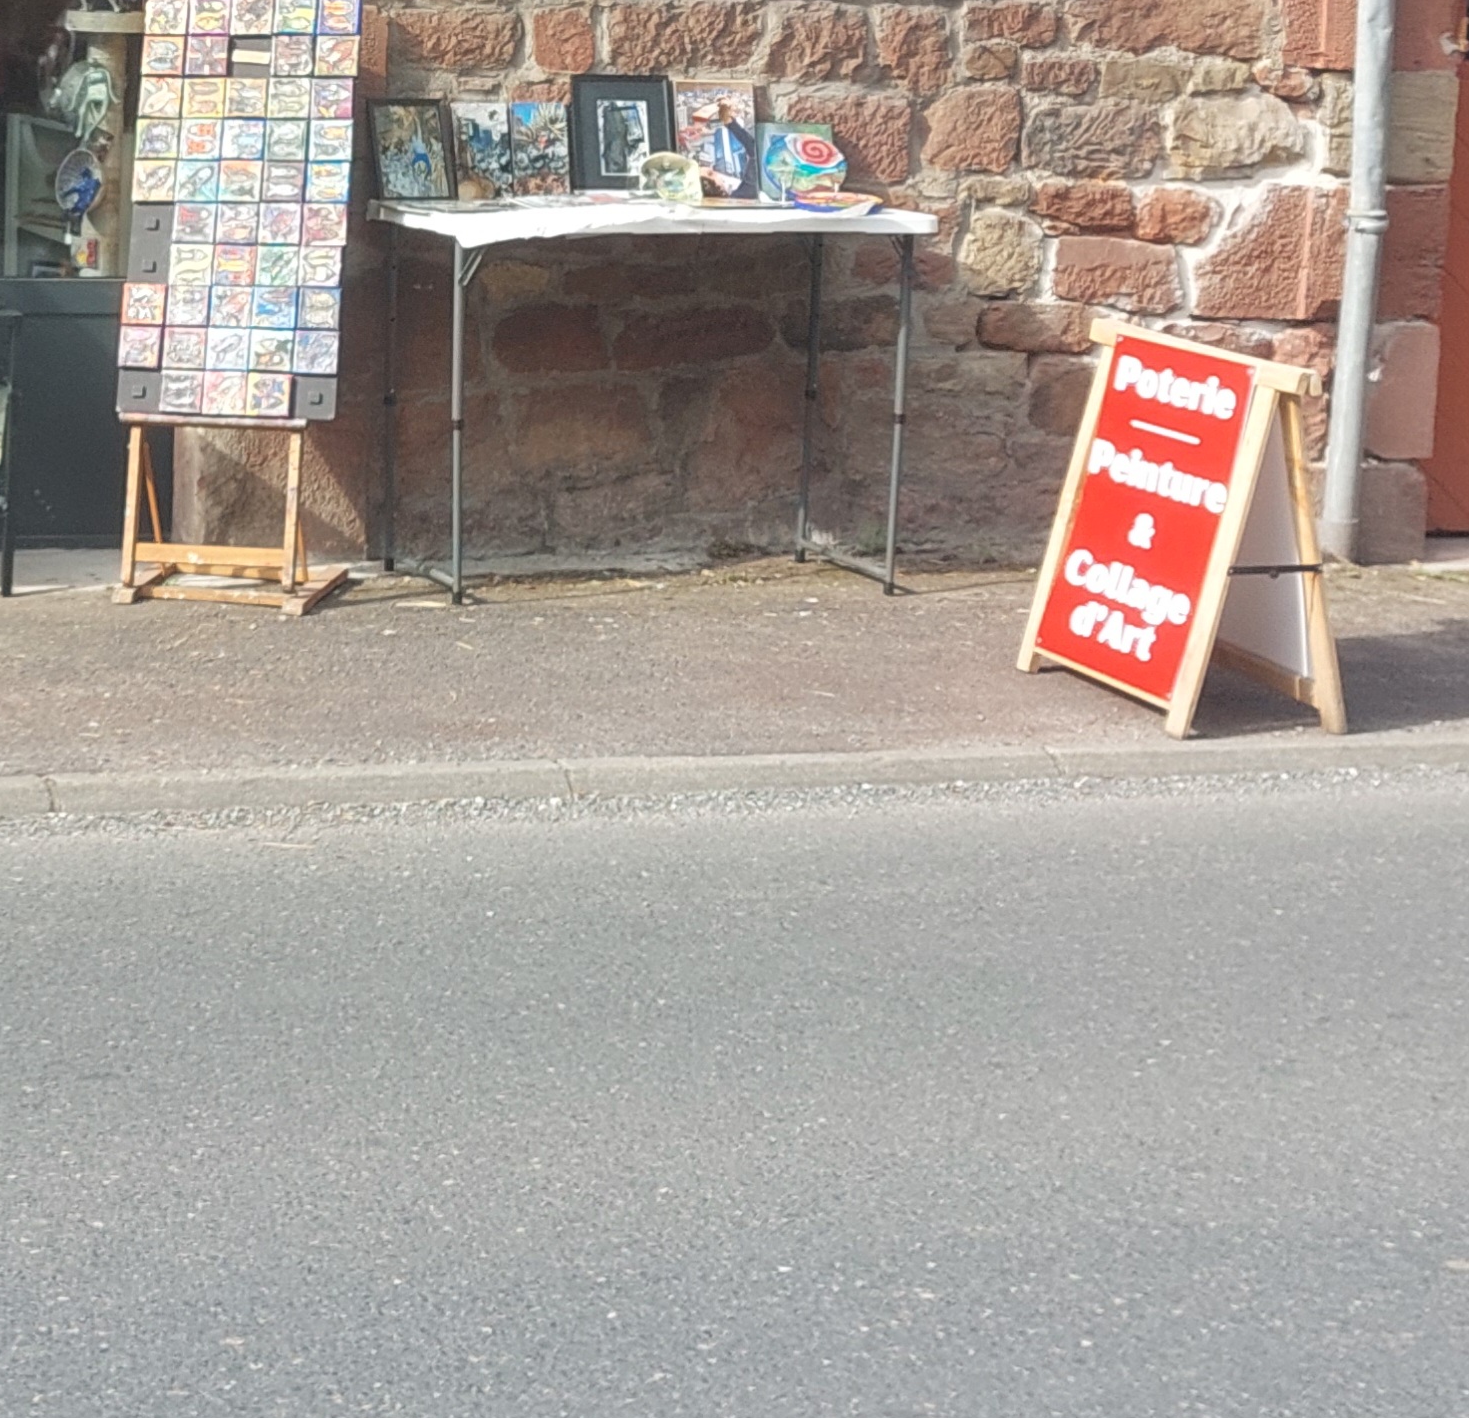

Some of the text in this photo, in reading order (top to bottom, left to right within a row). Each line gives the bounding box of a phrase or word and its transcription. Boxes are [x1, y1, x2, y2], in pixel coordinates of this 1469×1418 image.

[1114, 355, 1237, 420] Poterie
[1087, 438, 1227, 514] Peinture
[1127, 513, 1156, 550] &
[1064, 549, 1191, 625] Collage
[1069, 601, 1157, 662] d'Art
